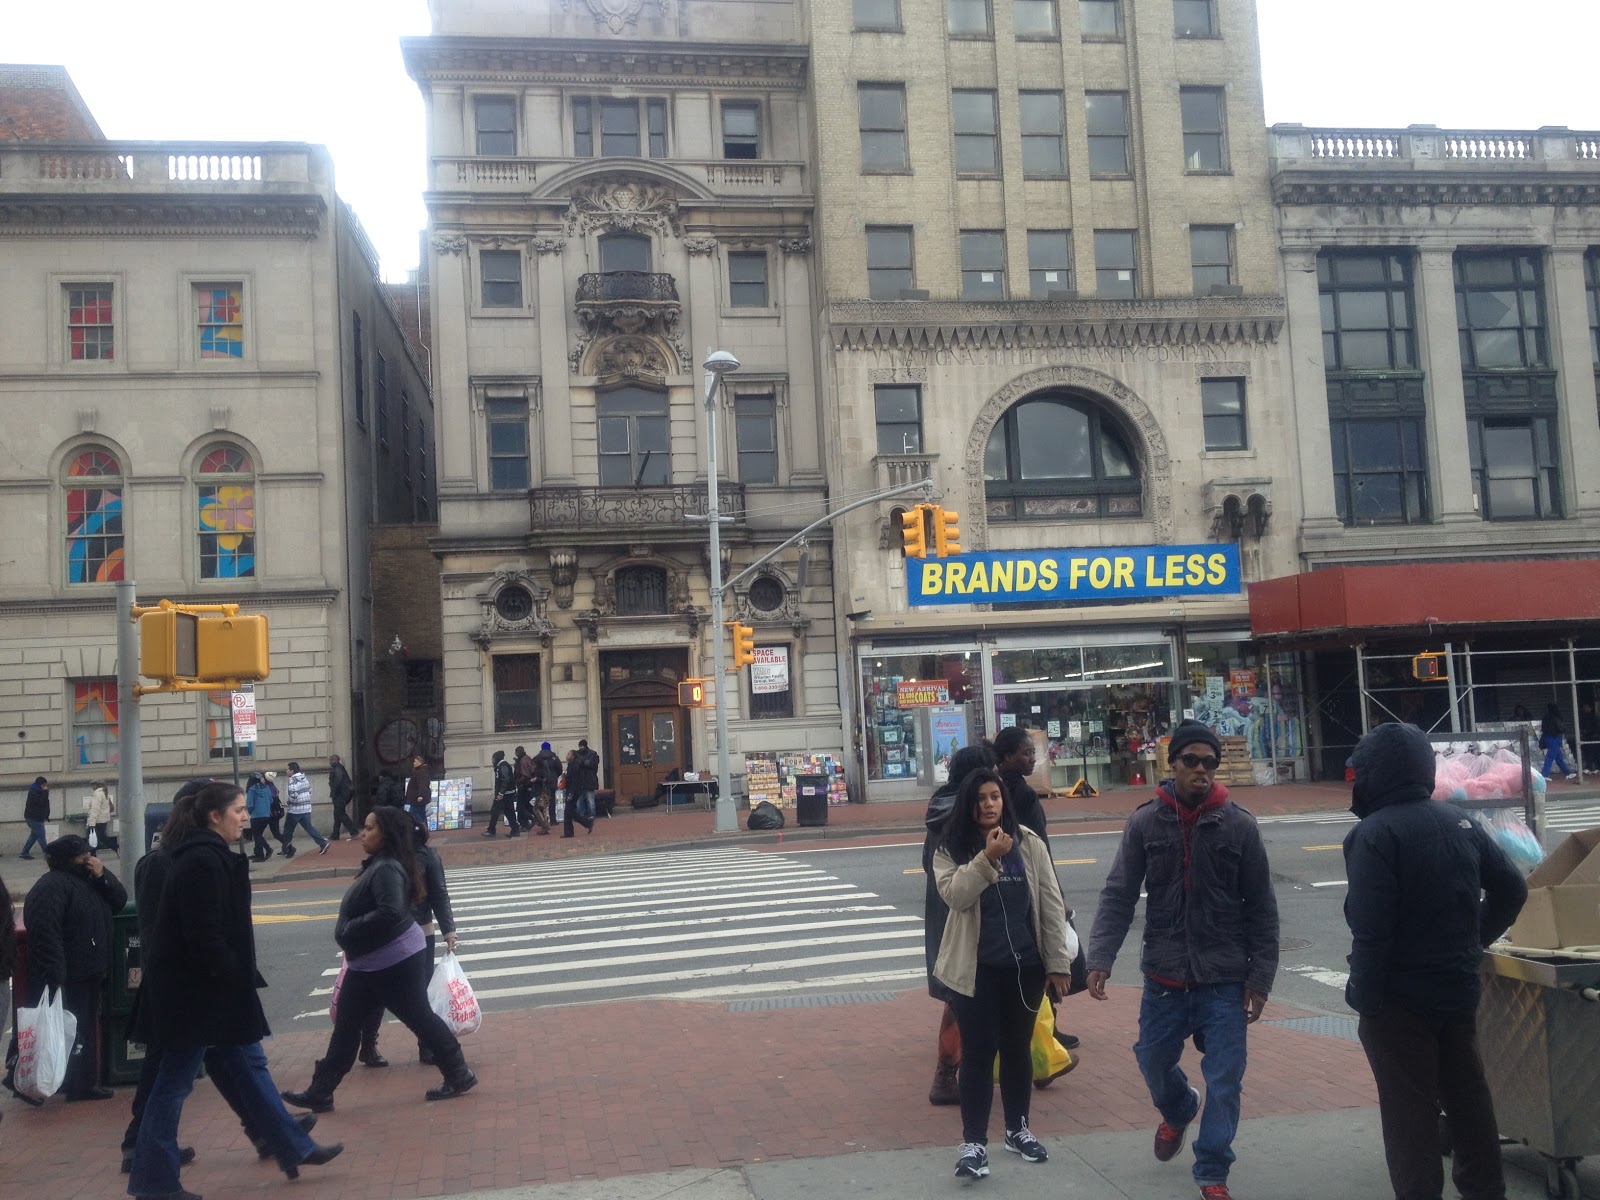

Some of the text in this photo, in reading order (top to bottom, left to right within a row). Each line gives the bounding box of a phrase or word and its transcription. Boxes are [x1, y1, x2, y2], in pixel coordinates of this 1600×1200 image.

[894, 345, 1229, 366] NATIONAL TITLE GUARANTY COMPANY
[921, 553, 1227, 595] BRANDS FOR LESS
[754, 656, 787, 664] AVAILABLE
[915, 691, 936, 703] COATS
